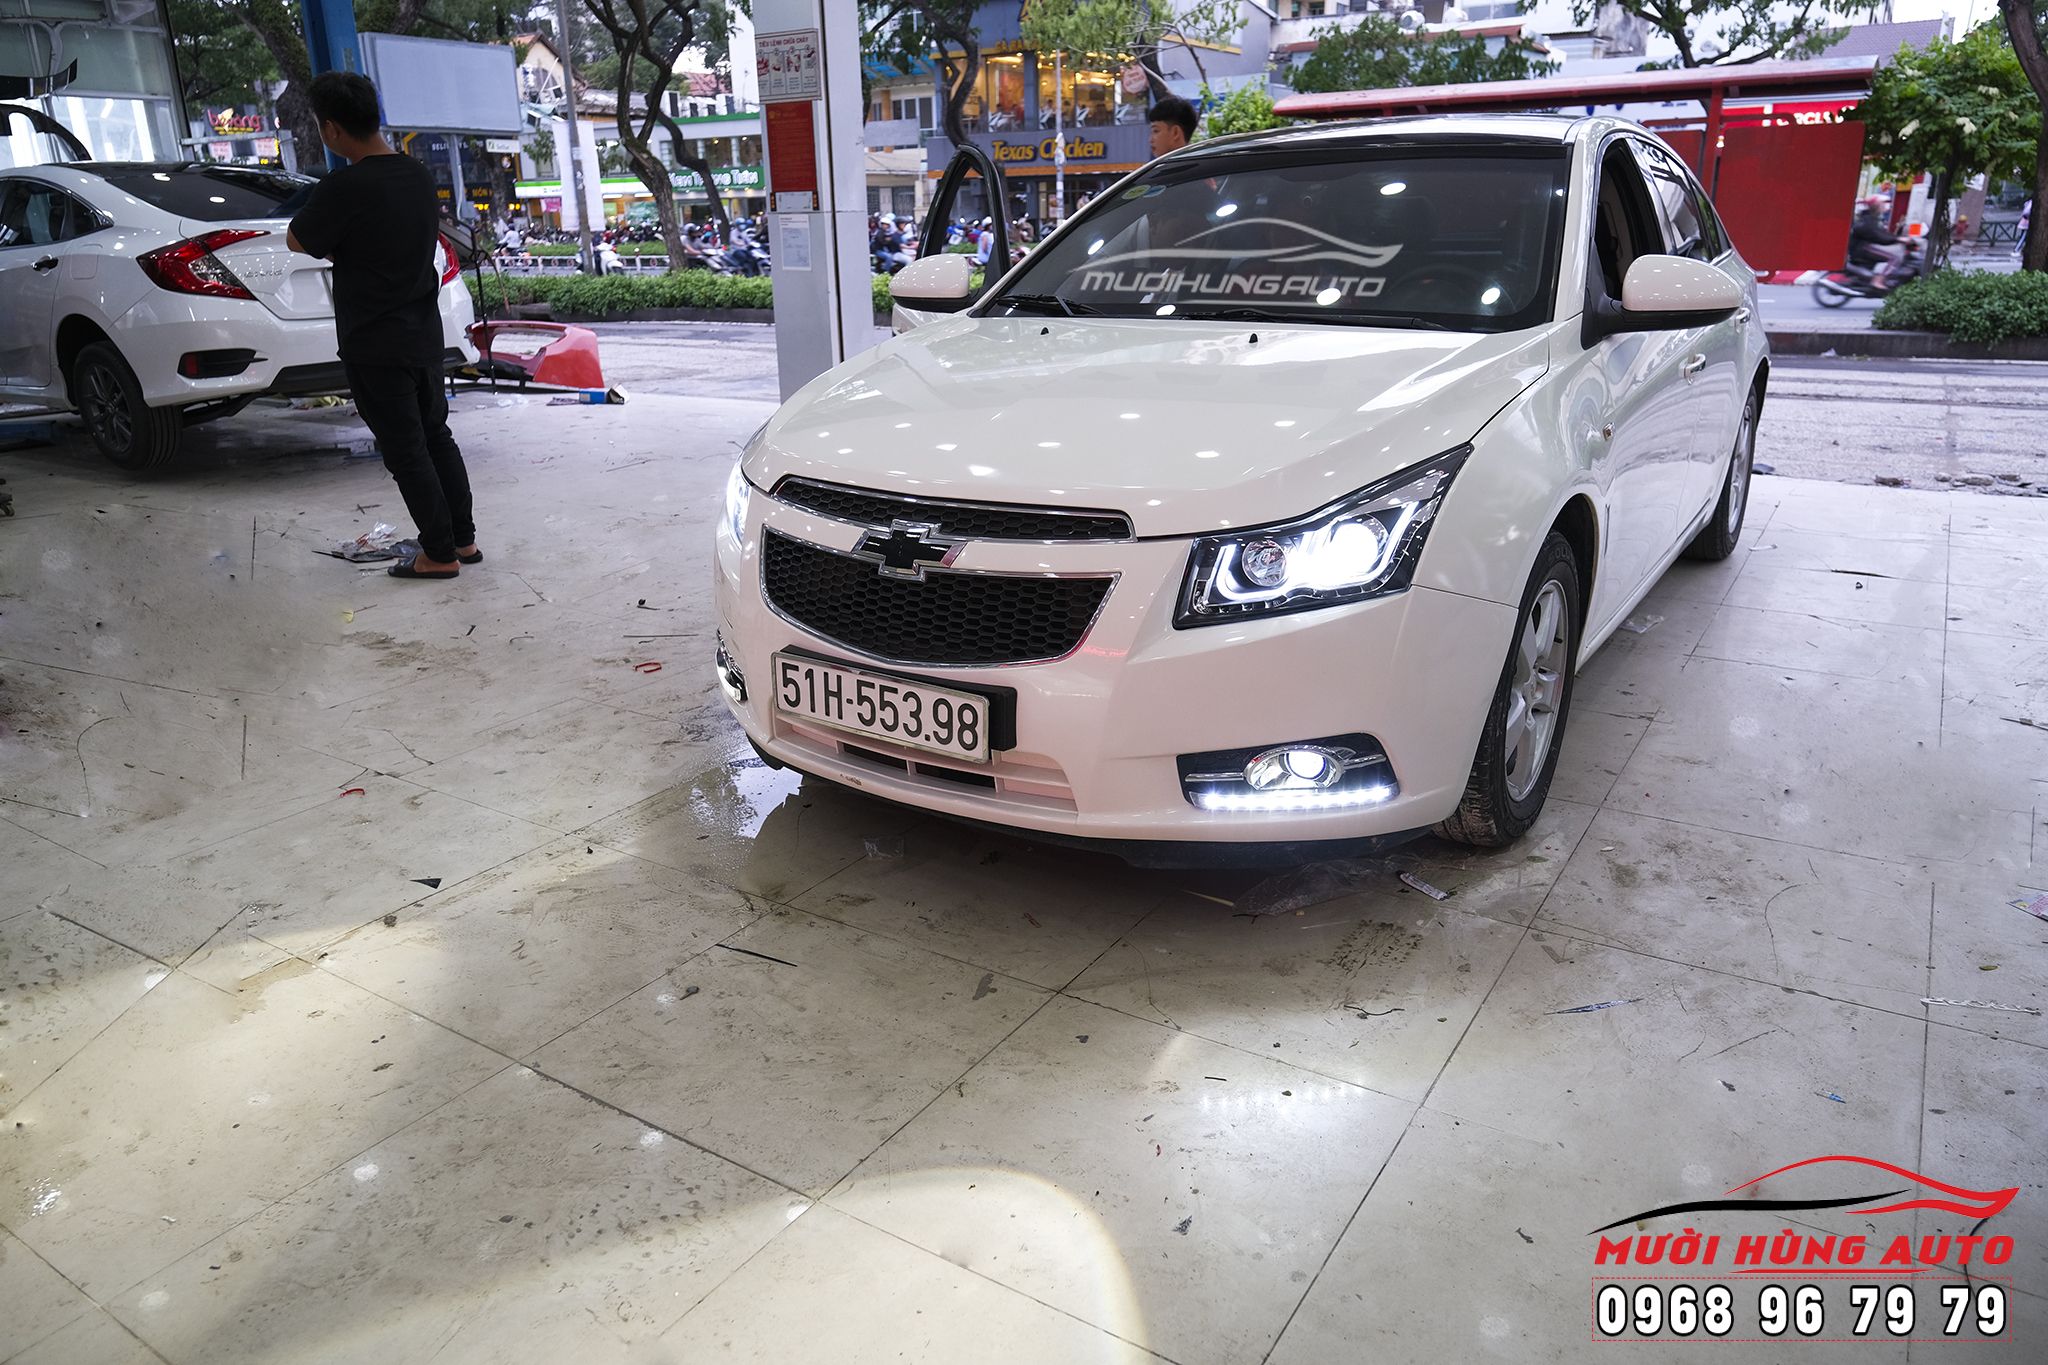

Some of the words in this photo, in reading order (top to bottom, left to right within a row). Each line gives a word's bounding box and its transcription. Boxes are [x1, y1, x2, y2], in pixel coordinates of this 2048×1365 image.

[992, 139, 1036, 161] Texas
[1039, 135, 1105, 159] Ccken
[781, 661, 979, 752] 51H-553.98
